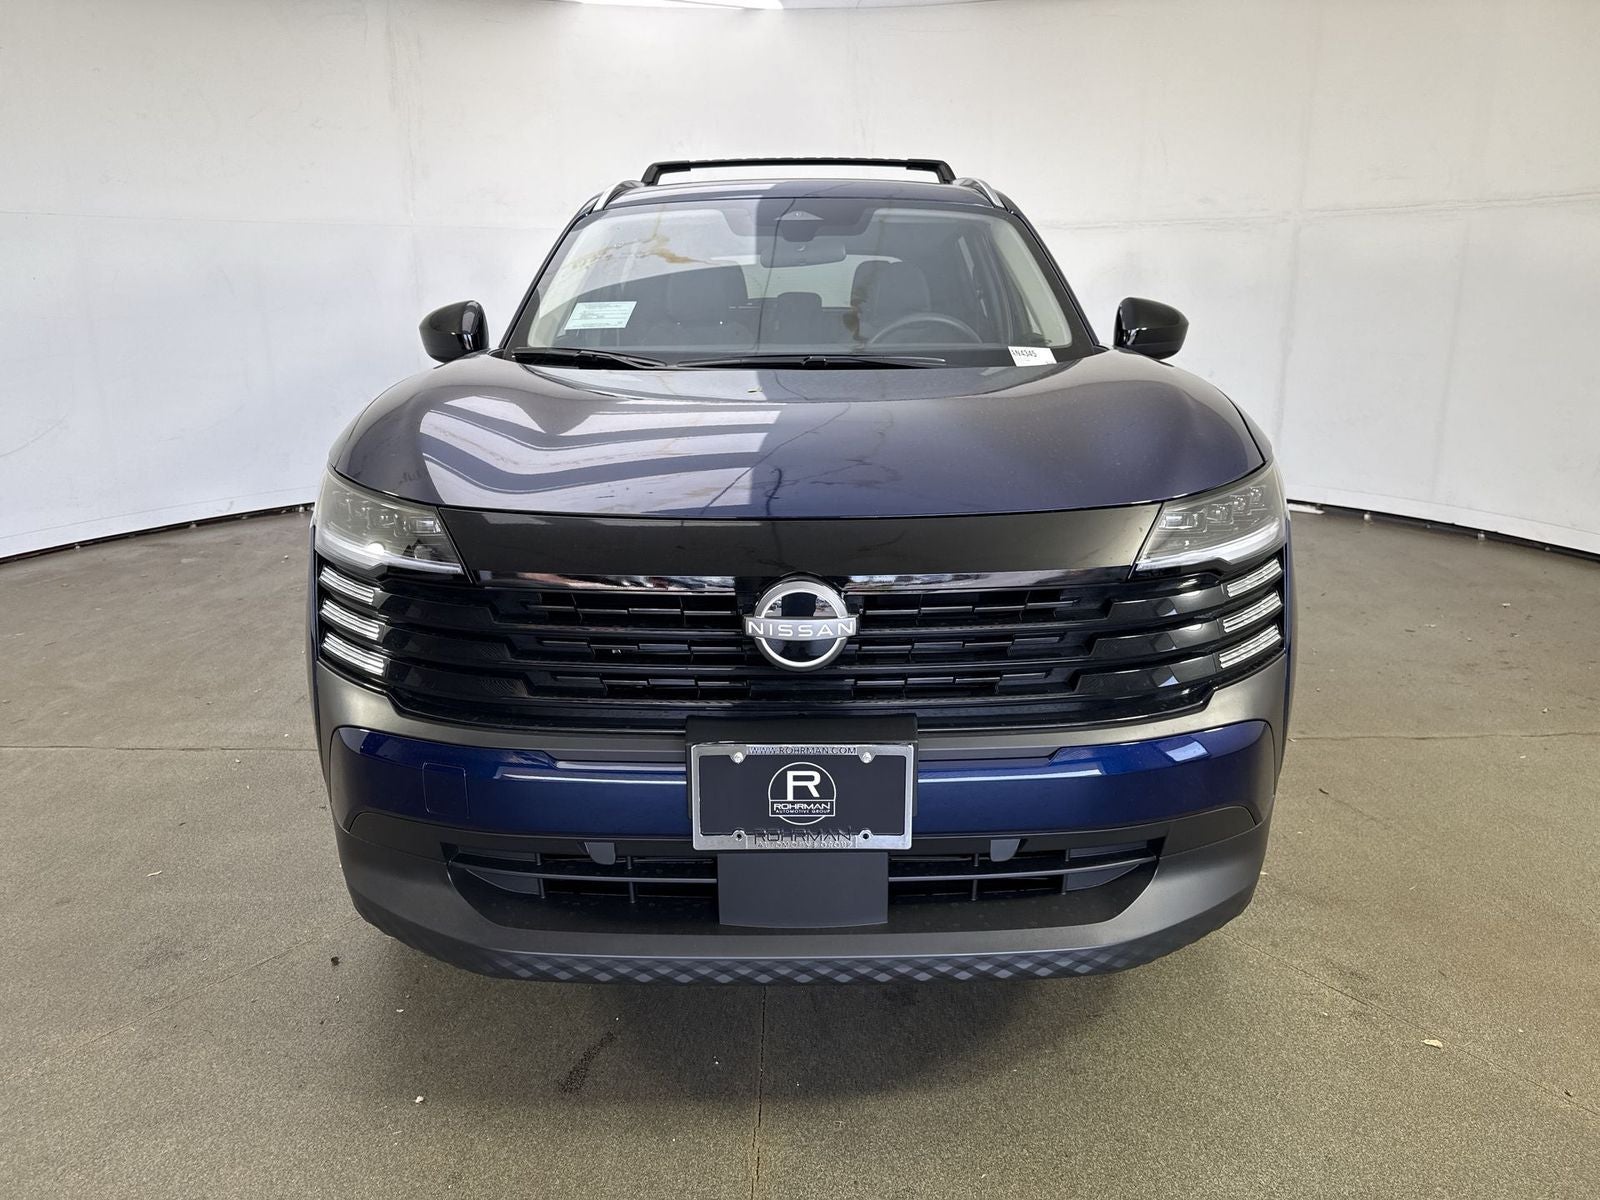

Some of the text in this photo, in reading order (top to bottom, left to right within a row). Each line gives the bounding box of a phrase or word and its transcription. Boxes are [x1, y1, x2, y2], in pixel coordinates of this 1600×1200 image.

[748, 621, 853, 637] NISSAN
[787, 770, 821, 800] R
[774, 802, 830, 811] ROHRMAN
[754, 829, 851, 844] ROHRMAN
